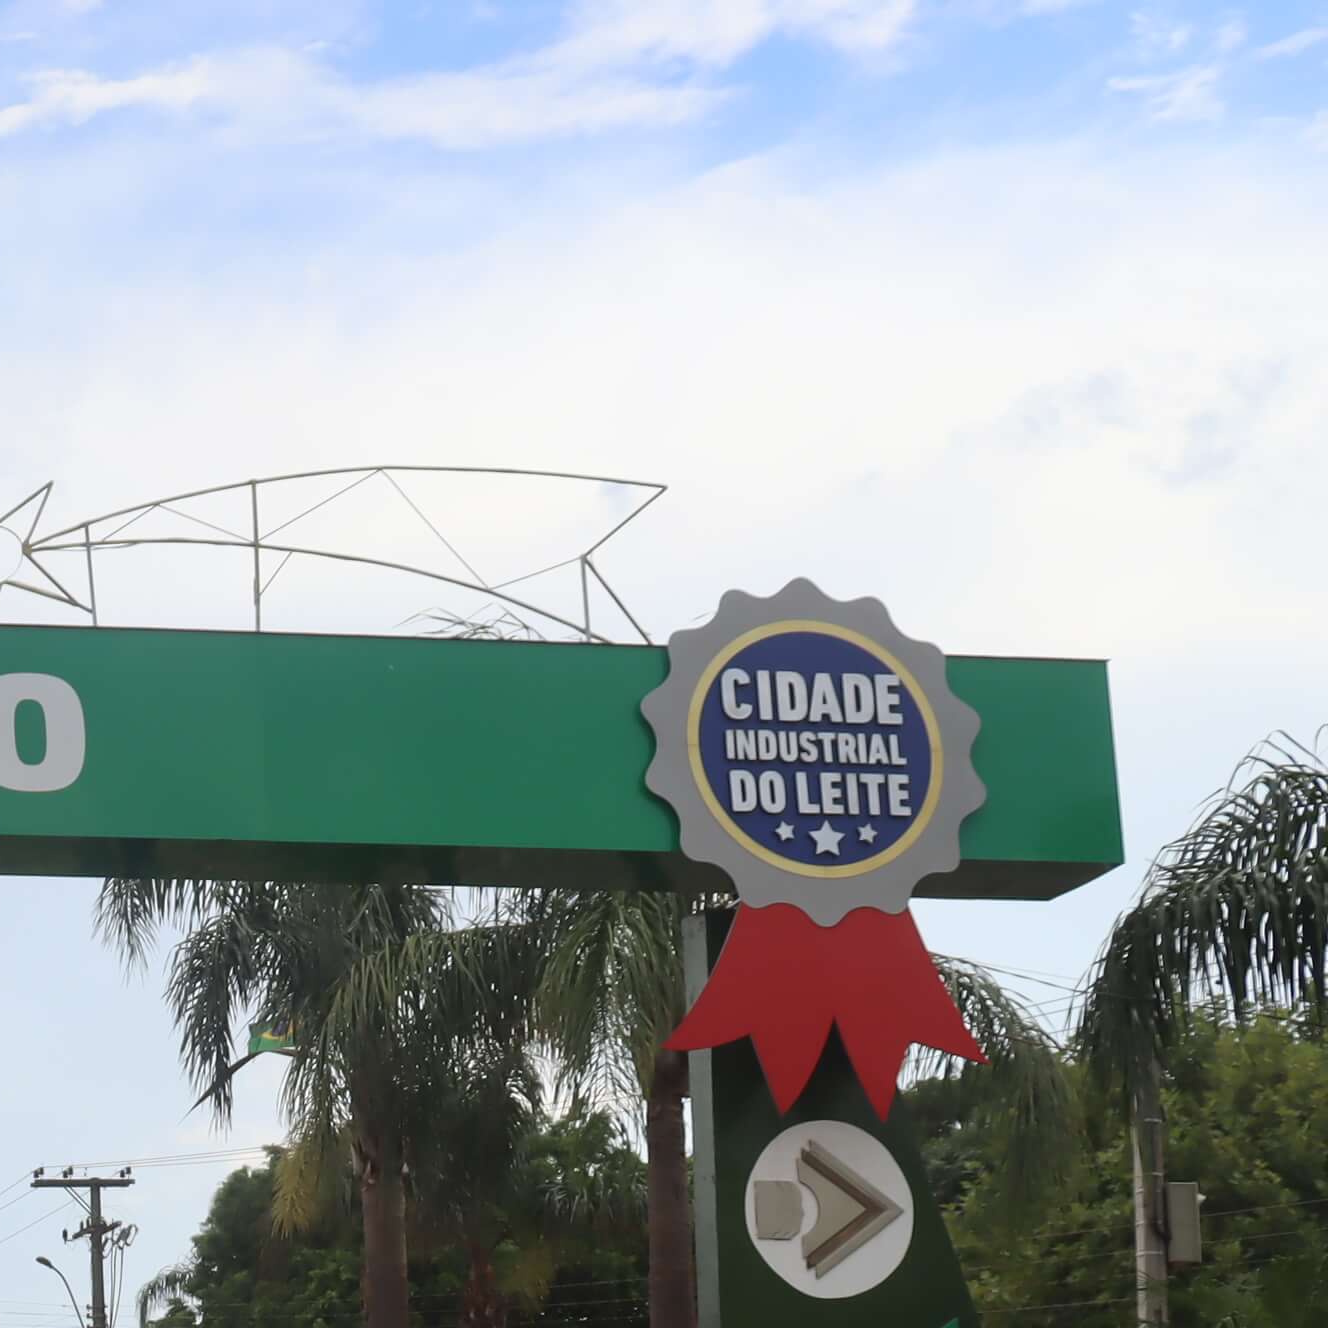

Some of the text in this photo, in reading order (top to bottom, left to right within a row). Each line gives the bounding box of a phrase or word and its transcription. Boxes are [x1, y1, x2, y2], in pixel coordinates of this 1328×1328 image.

[720, 667, 904, 725] CIDADE
[724, 728, 907, 766] INDUSTRIAL
[729, 769, 912, 817] DO LEITE
